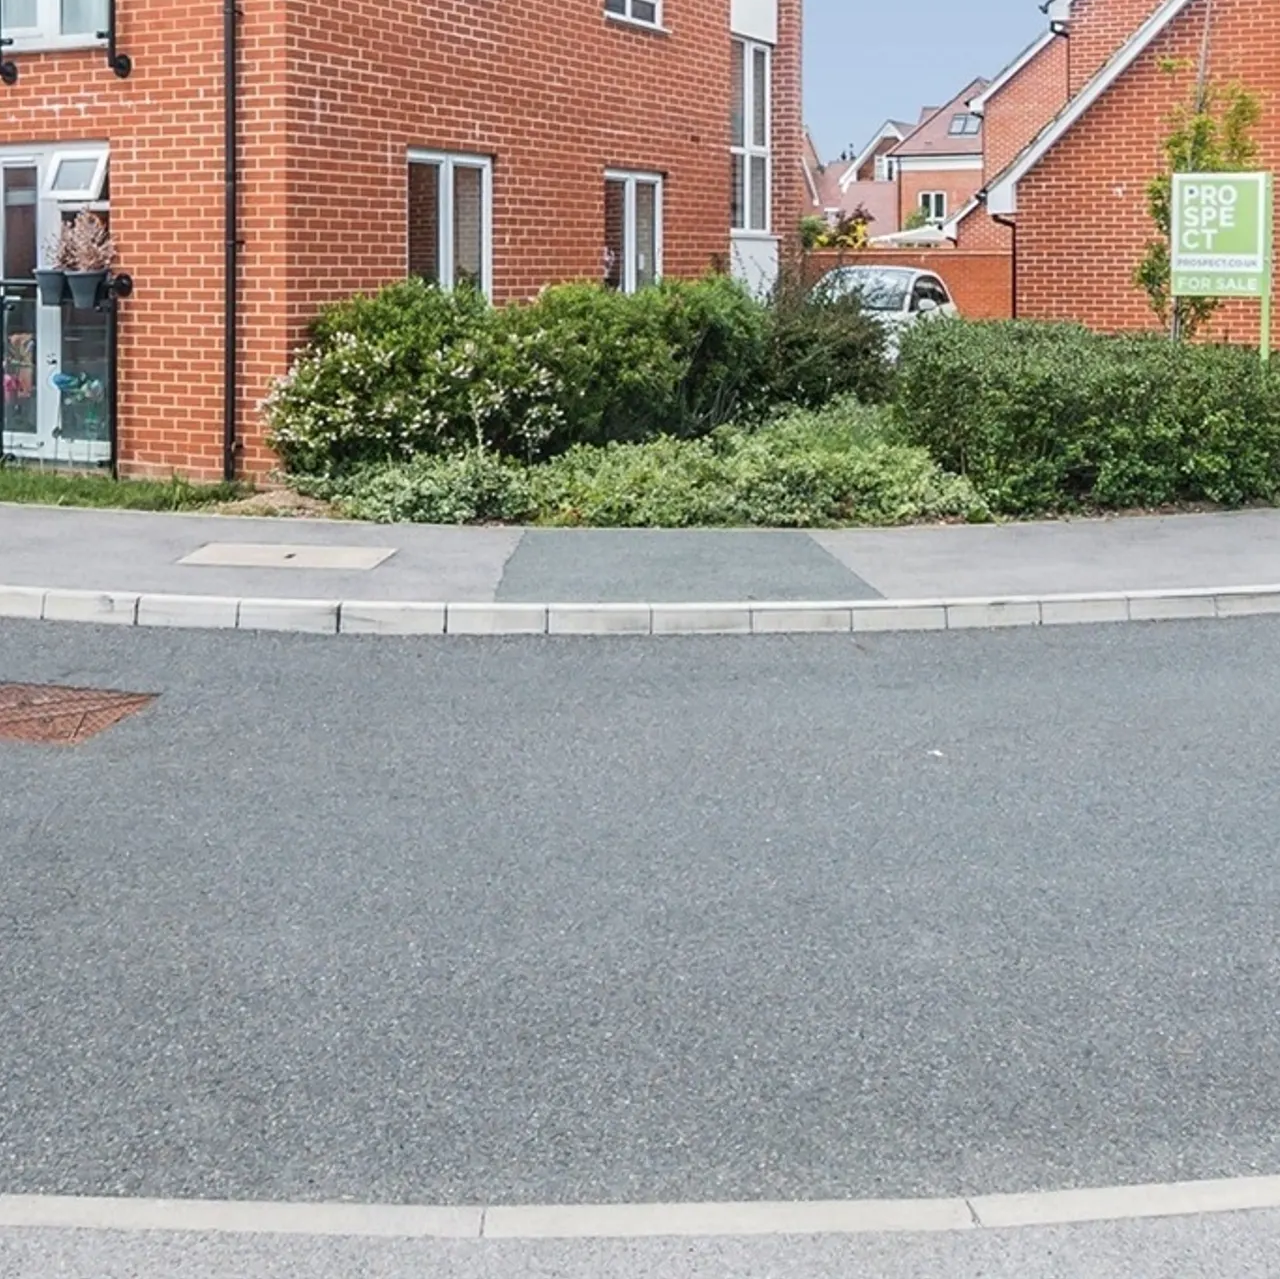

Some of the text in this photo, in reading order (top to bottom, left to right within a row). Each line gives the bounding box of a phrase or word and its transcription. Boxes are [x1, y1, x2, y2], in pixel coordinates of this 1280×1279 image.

[1183, 185, 1237, 205] PRO
[1183, 207, 1235, 227] SPE
[1182, 229, 1218, 250] CT
[1177, 277, 1258, 290] FOR SALE
